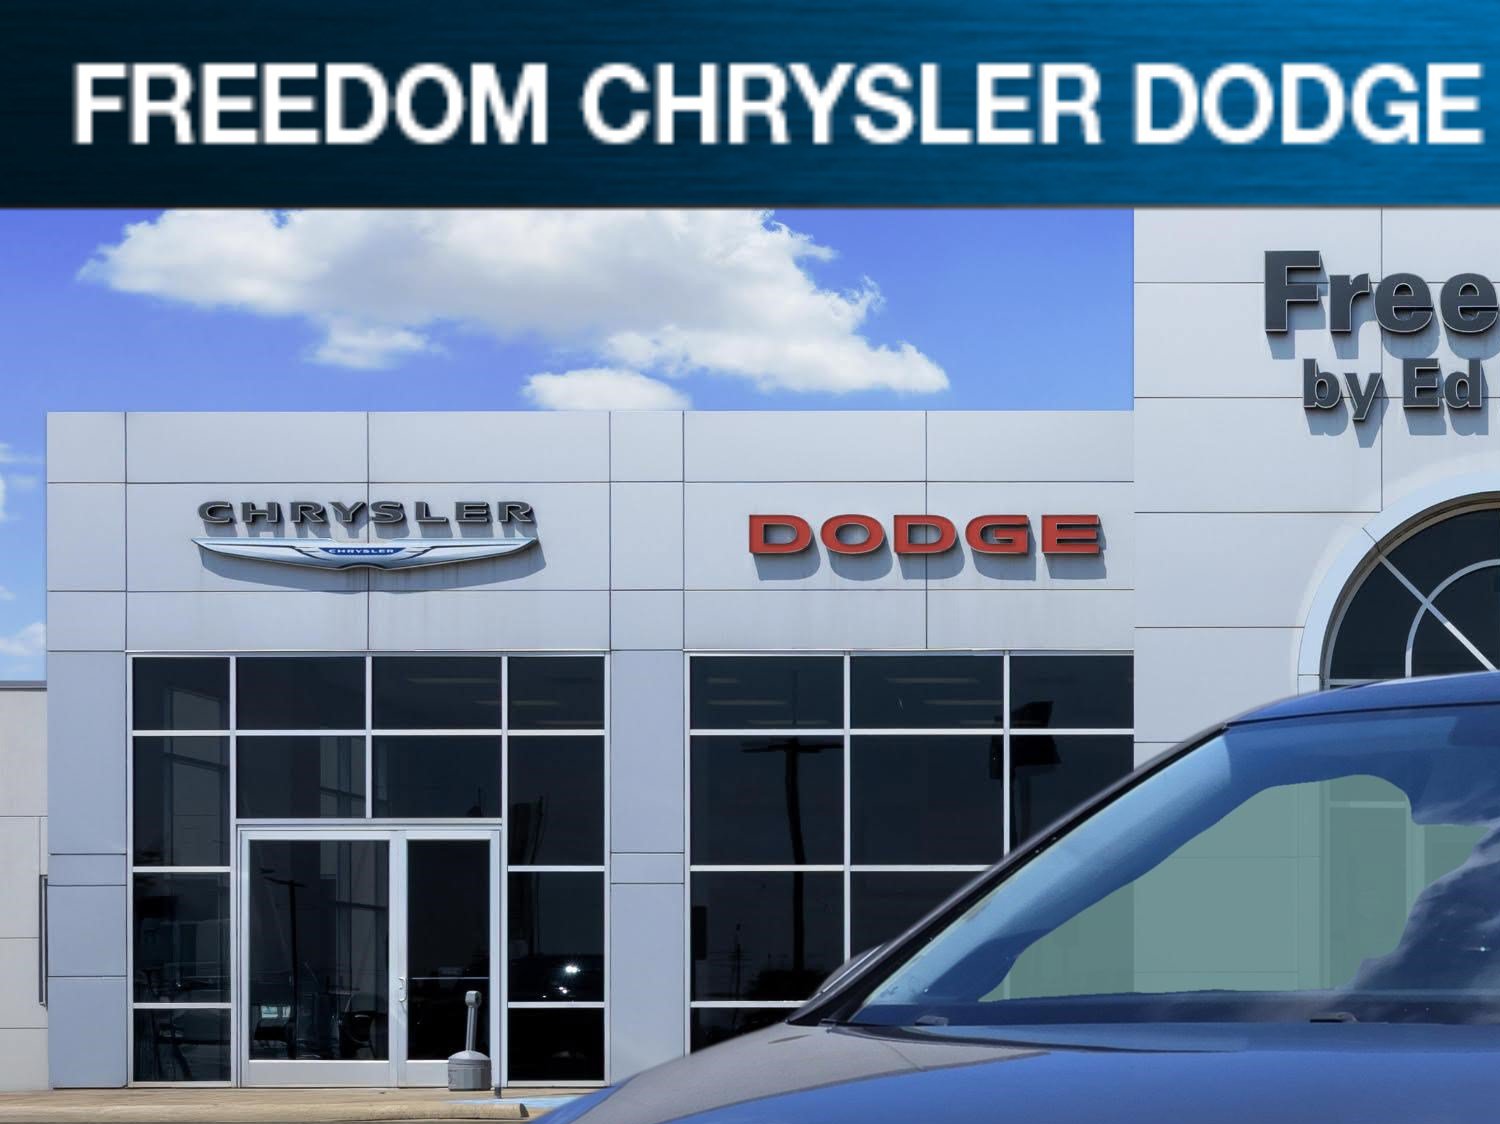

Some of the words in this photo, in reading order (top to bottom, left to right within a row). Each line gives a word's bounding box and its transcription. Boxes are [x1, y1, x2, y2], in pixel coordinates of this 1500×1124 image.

[1302, 358, 1384, 422] by
[1402, 357, 1483, 410] Ed
[198, 500, 534, 524] CHRYSLER
[749, 513, 1101, 554] DODGE
